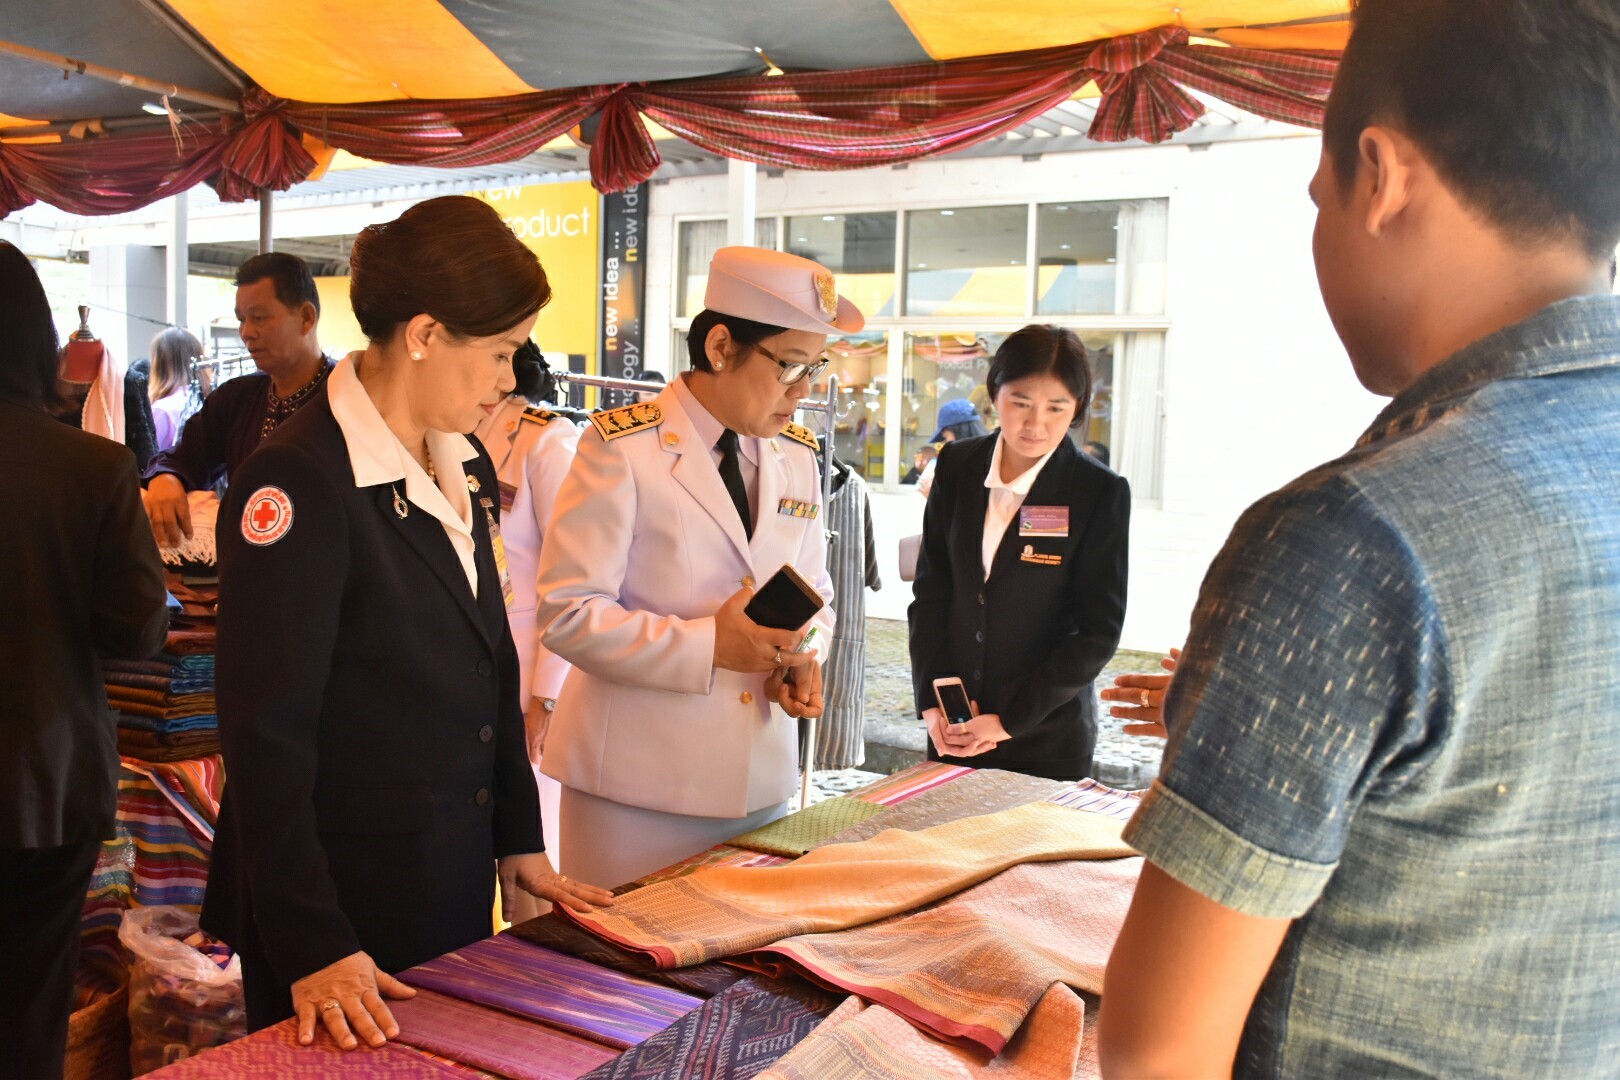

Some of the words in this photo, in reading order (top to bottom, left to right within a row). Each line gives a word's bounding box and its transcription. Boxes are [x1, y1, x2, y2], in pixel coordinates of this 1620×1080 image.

[622, 183, 638, 214] ide
[625, 218, 638, 262] new
[605, 307, 618, 351] new
